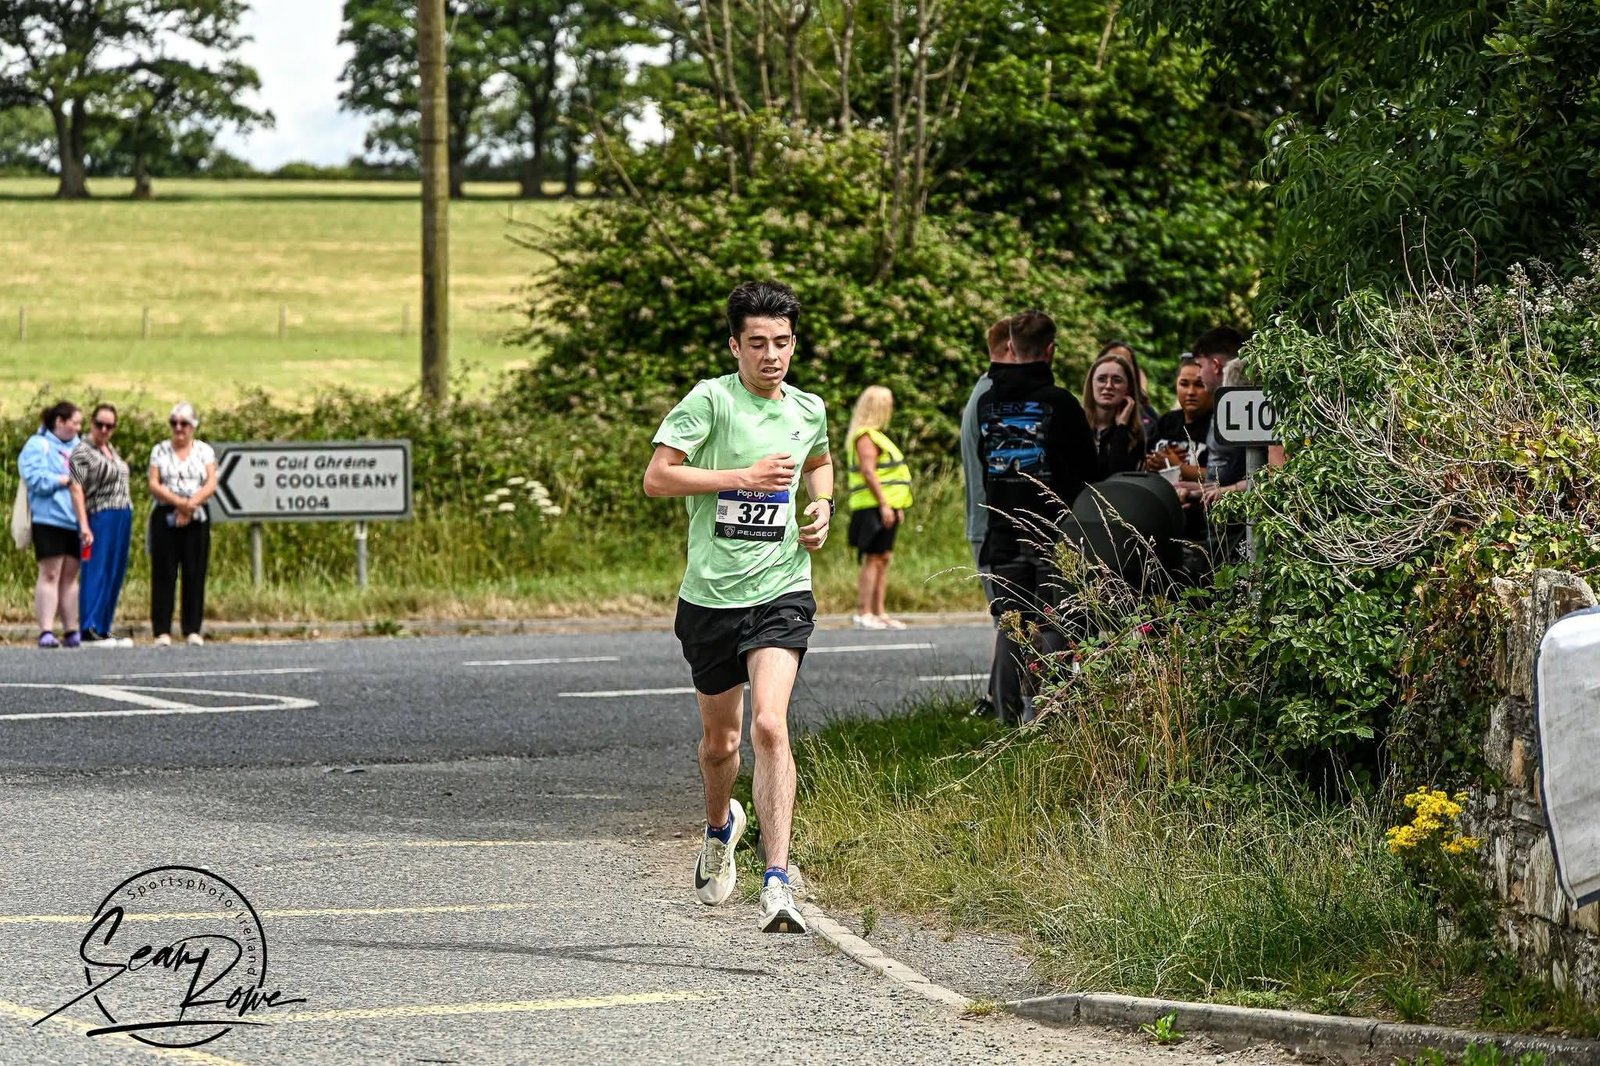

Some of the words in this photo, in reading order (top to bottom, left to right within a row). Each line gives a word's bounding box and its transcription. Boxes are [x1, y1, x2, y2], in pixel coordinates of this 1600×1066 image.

[1226, 400, 1278, 431] L10
[249, 457, 270, 468] km
[254, 473, 266, 489] 3
[276, 473, 399, 489] COOLGREANY
[737, 488, 752, 499] Pop
[753, 491, 765, 500] Up
[276, 495, 330, 511] L1004
[737, 502, 779, 525] 327
[737, 529, 778, 538] PEUGEOT
